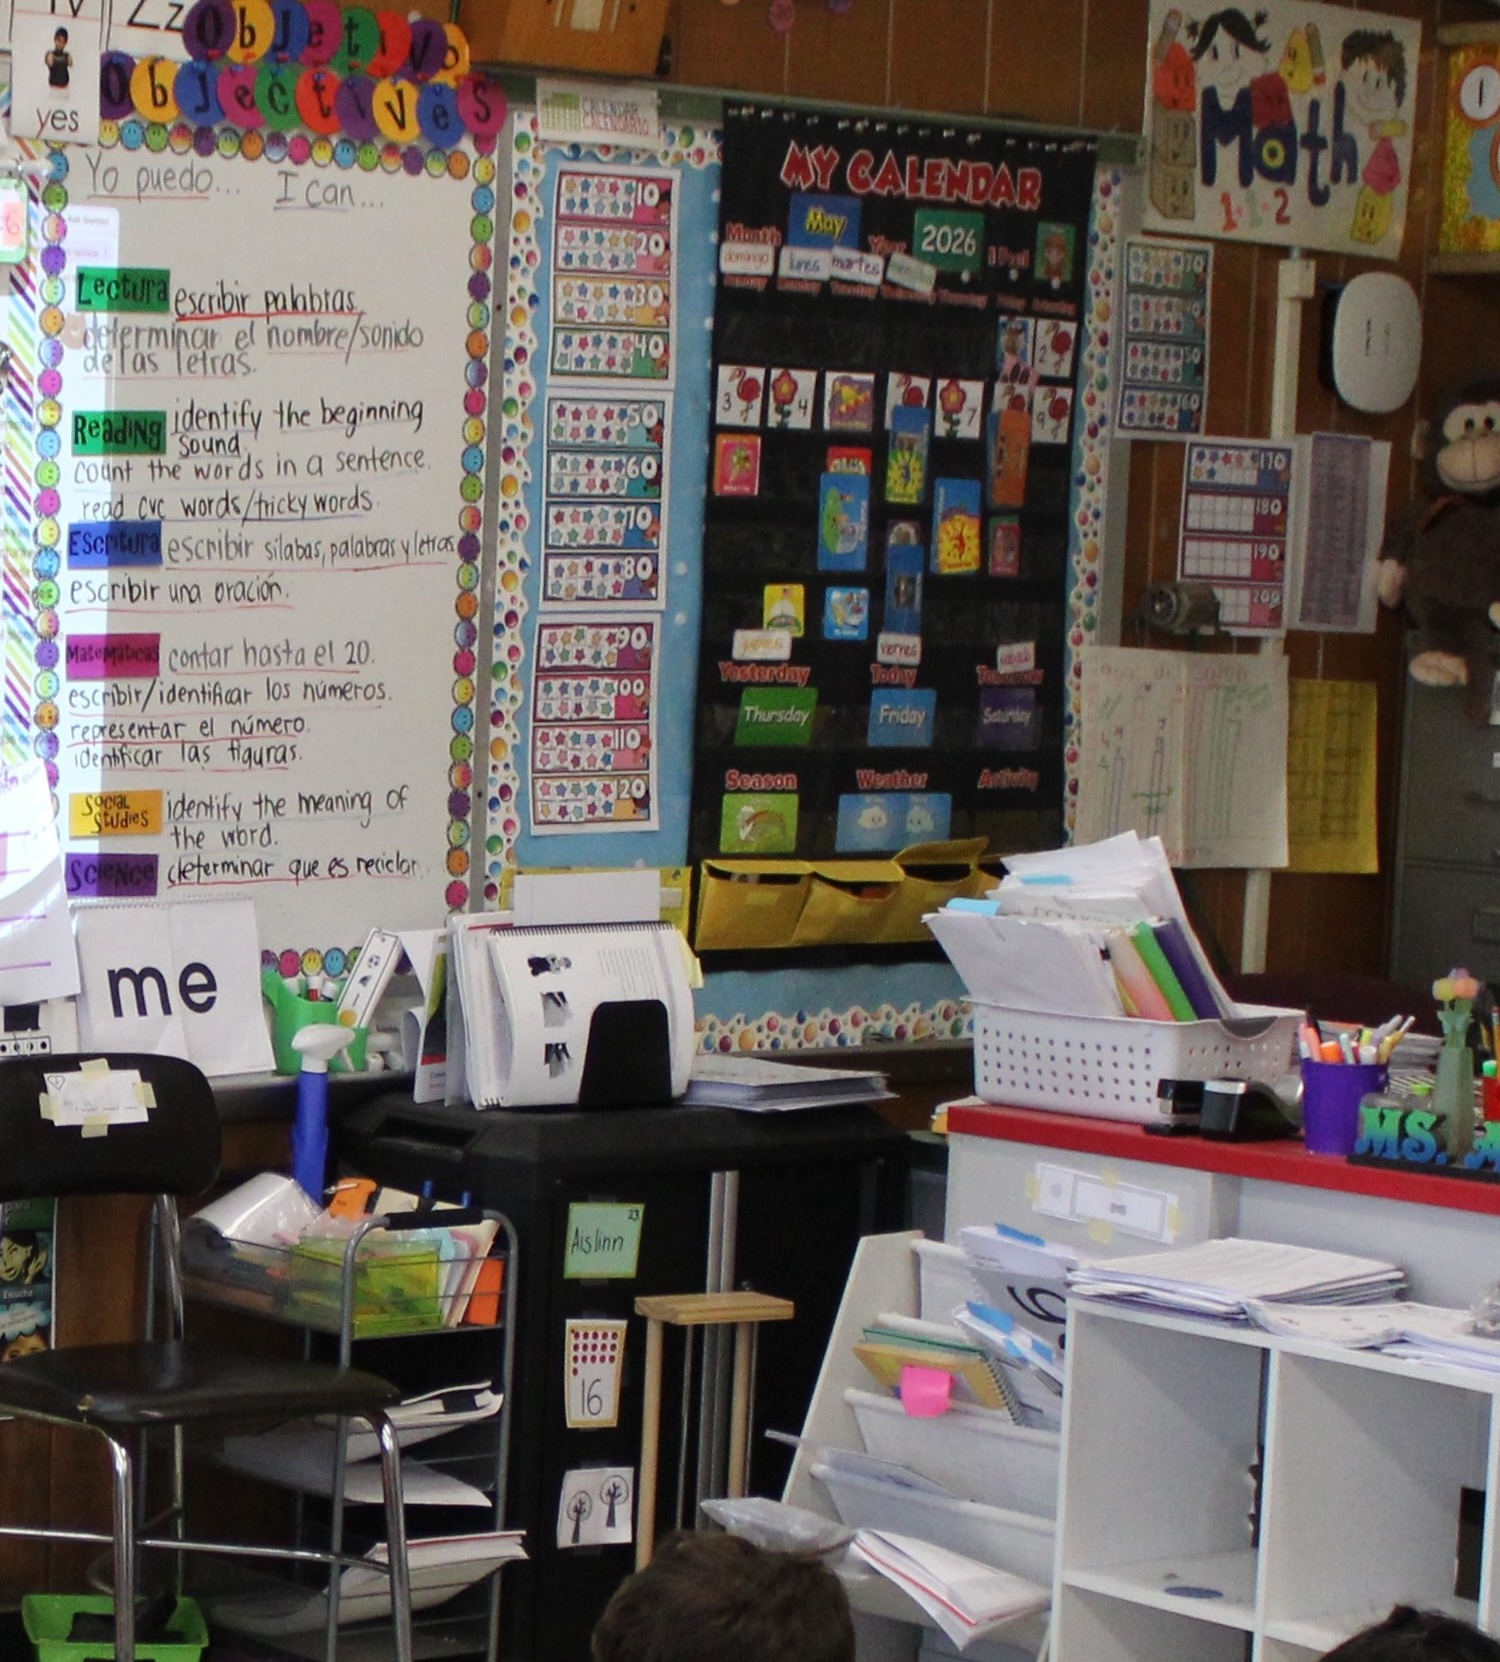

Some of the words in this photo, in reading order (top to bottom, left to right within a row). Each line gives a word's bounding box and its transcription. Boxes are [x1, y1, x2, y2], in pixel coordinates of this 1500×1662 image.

[36, 107, 79, 137] yes
[1201, 73, 1360, 207] Math
[781, 140, 841, 190] MY
[846, 148, 1043, 212] CALENDAR
[804, 207, 847, 238] May
[921, 225, 977, 257] 2026
[830, 254, 881, 278] martes
[77, 272, 169, 303] Lectura
[83, 317, 217, 351] determinar
[235, 321, 256, 347] el
[267, 312, 424, 364] nombre/sonido
[174, 398, 263, 443] identify
[273, 400, 310, 427] the
[321, 398, 423, 437] beginning
[74, 459, 133, 483] count
[148, 458, 182, 481] the
[195, 456, 264, 480] words
[276, 454, 295, 477] in
[307, 456, 323, 476] a
[70, 577, 160, 604] escribir
[169, 584, 201, 604] una
[168, 645, 234, 669] contar
[244, 639, 306, 667] hasta
[314, 640, 335, 666] el
[719, 661, 811, 686] Yesterday
[870, 664, 918, 688] Today
[266, 677, 290, 700] los
[70, 718, 186, 742] representar
[200, 719, 214, 738] el
[743, 705, 810, 726] Thursday
[878, 705, 927, 726] Friday
[982, 707, 1032, 726] Saturday
[725, 769, 798, 790] Season
[856, 768, 929, 790] Weather
[167, 788, 243, 820] identify
[253, 789, 286, 816] the
[299, 790, 373, 828] meaning
[385, 785, 410, 811] of
[172, 823, 205, 848] the
[107, 961, 217, 1018] me
[628, 1208, 640, 1221] 23
[571, 1227, 625, 1256] Aislinn
[579, 1378, 602, 1416] 16
